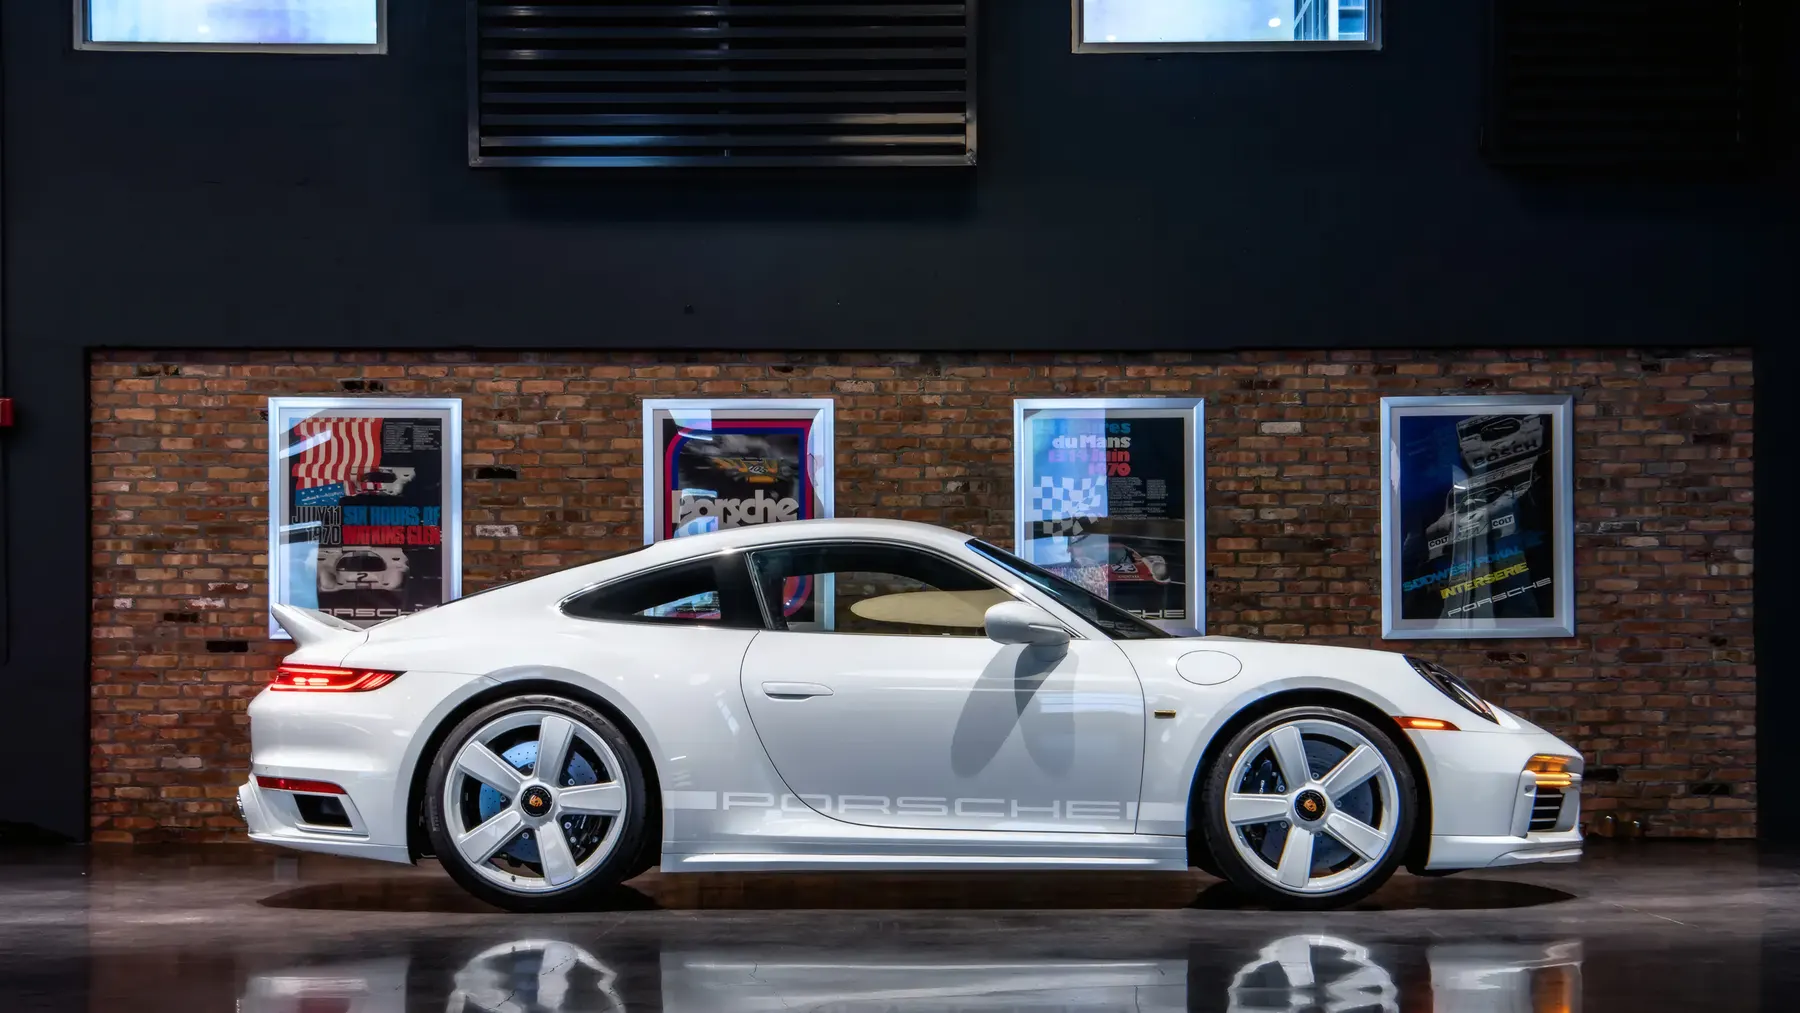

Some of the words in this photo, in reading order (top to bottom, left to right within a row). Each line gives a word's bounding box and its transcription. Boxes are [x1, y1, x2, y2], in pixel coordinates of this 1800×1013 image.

[1052, 436, 1078, 449] du
[1079, 434, 1131, 449] Mans
[292, 505, 328, 526] JULY
[370, 505, 421, 526] HOURS
[423, 505, 441, 526] OF
[671, 489, 799, 526] Porsche
[1493, 516, 1514, 528] COLT
[306, 525, 342, 545] 1970
[342, 525, 405, 545] WATKINS
[1429, 537, 1449, 549] COLT
[357, 572, 368, 582] 2
[1439, 561, 1529, 600] INTERSERIE
[1447, 577, 1552, 618] PORSCHE
[722, 791, 1121, 820] PORSCHE
